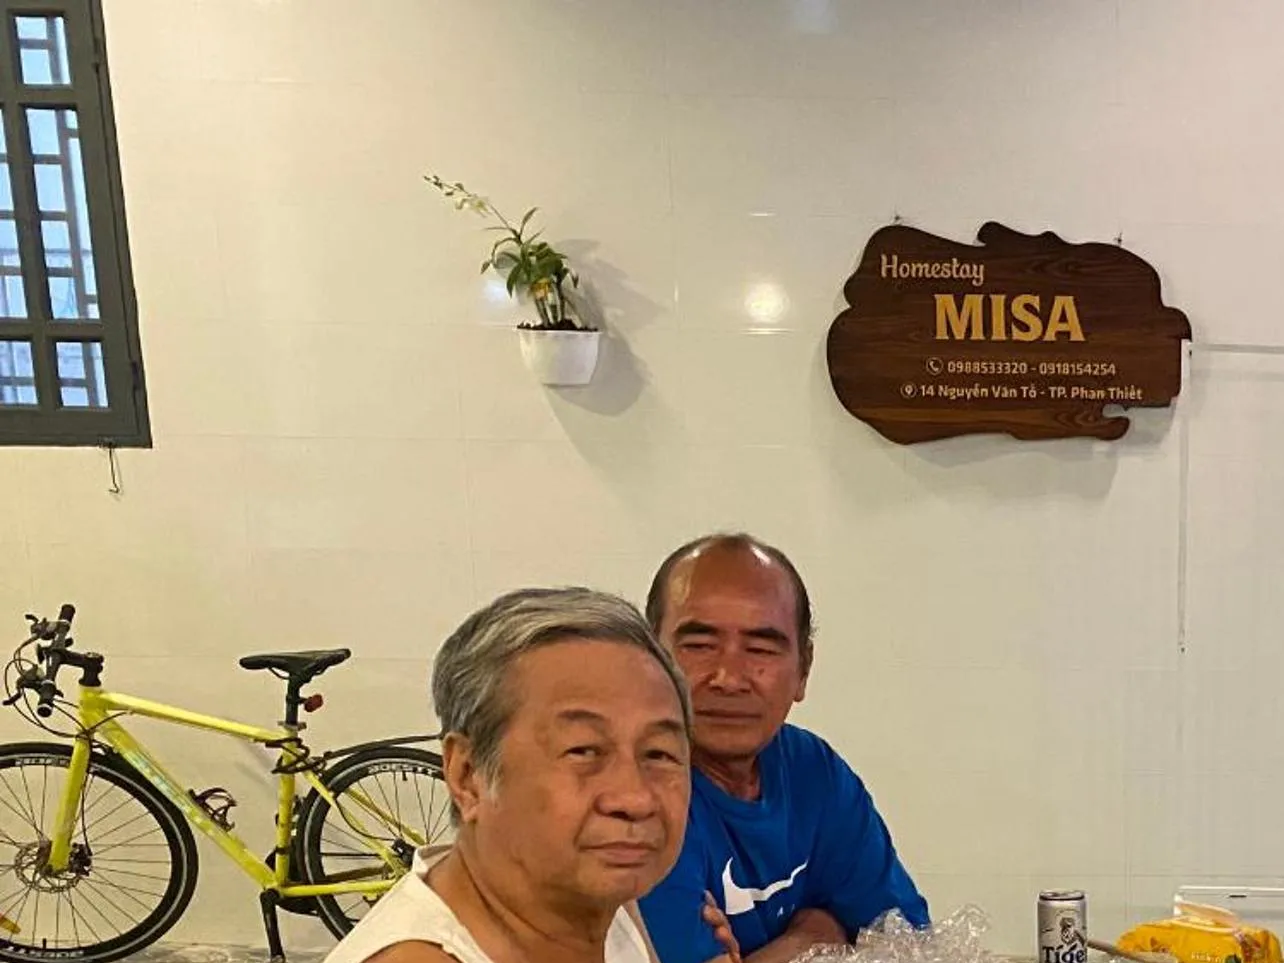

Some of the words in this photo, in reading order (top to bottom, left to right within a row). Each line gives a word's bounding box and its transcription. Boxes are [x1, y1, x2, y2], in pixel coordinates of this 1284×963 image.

[880, 254, 984, 286] Homestay
[934, 293, 1086, 342] MISA
[947, 361, 1028, 374] 0988533320
[1039, 362, 1116, 376] 0918154254
[920, 384, 935, 397] 14
[1048, 386, 1068, 398] TP.
[1070, 386, 1105, 399] Phan
